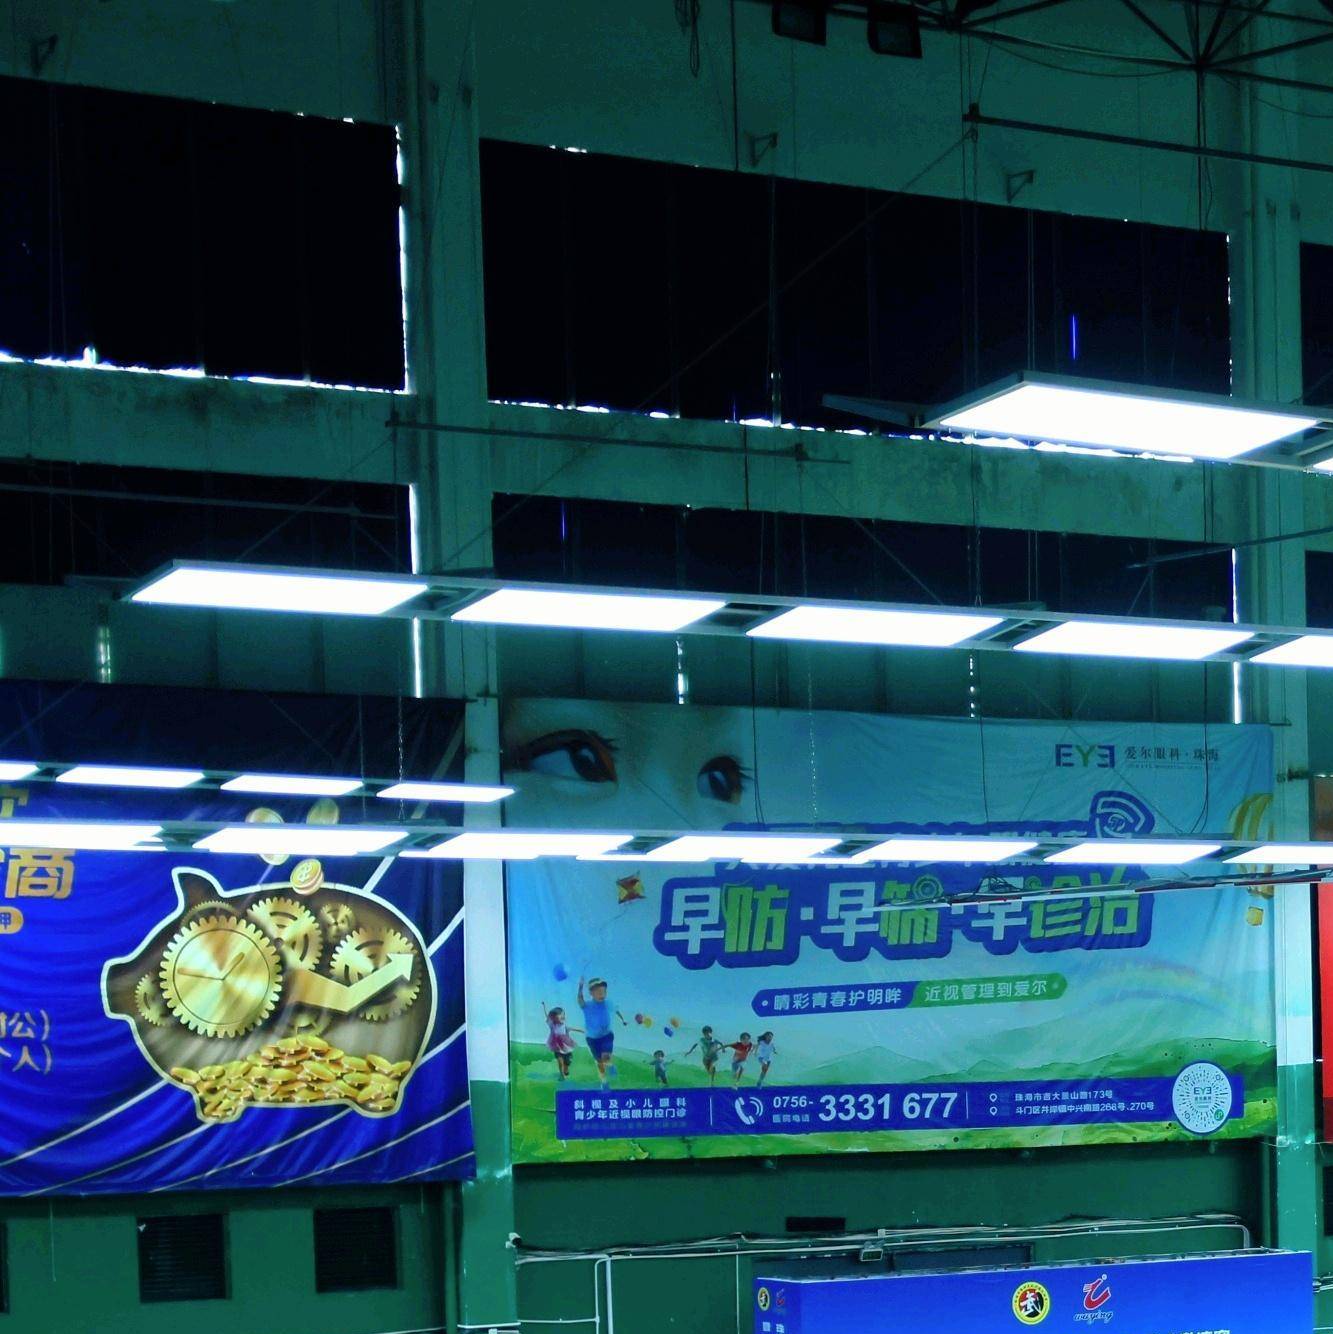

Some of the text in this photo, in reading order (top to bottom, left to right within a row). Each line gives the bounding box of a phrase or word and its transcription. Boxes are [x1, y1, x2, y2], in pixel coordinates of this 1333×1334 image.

[0, 847, 75, 899] 商
[924, 978, 1049, 1003] 近视管理到爱尔
[773, 1096, 813, 1108] 0756-
[819, 1092, 959, 1124] 3331 677
